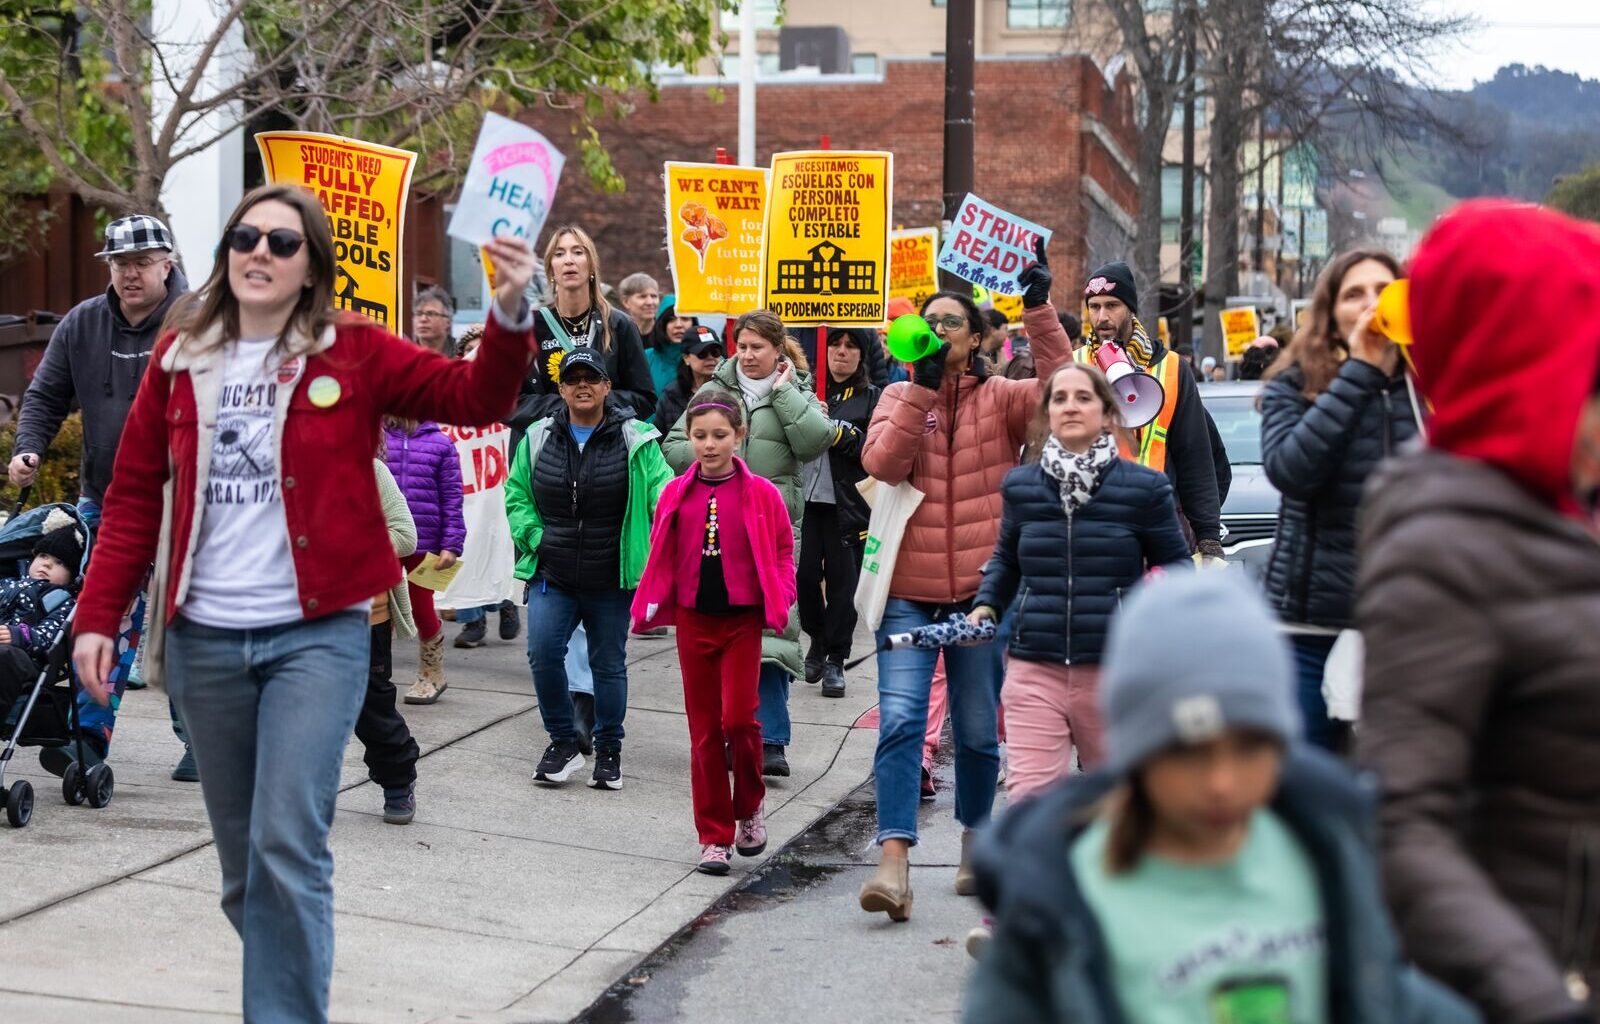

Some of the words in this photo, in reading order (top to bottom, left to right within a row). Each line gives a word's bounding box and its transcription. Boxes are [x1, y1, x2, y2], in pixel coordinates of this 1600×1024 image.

[301, 145, 353, 170] STUDENTS
[356, 154, 382, 176] NEED
[794, 161, 859, 173] NECESITAMOS
[304, 164, 376, 196] FULLY
[677, 178, 704, 193] WE
[708, 179, 759, 195] CAN'T
[782, 173, 843, 190] ESCUELAS
[848, 173, 875, 189] CON
[715, 196, 761, 211] WAIT
[793, 189, 860, 206] PERSONAL
[317, 188, 391, 229] AFFED,
[788, 206, 859, 222] COMPLETO
[327, 216, 379, 246] ABLE
[741, 218, 763, 231] for
[791, 223, 799, 239] Y
[804, 223, 861, 239] ESTABLE
[739, 233, 763, 245] the
[334, 240, 391, 272] OOLS
[740, 263, 759, 273] ou
[706, 274, 760, 288] student
[709, 288, 758, 303] deserv
[769, 302, 783, 317] NO
[784, 302, 835, 318] PODEMOS
[837, 302, 882, 319] ESPERAR
[221, 383, 277, 408] UCATO
[205, 481, 245, 505] OCAL
[254, 479, 281, 505] 107
